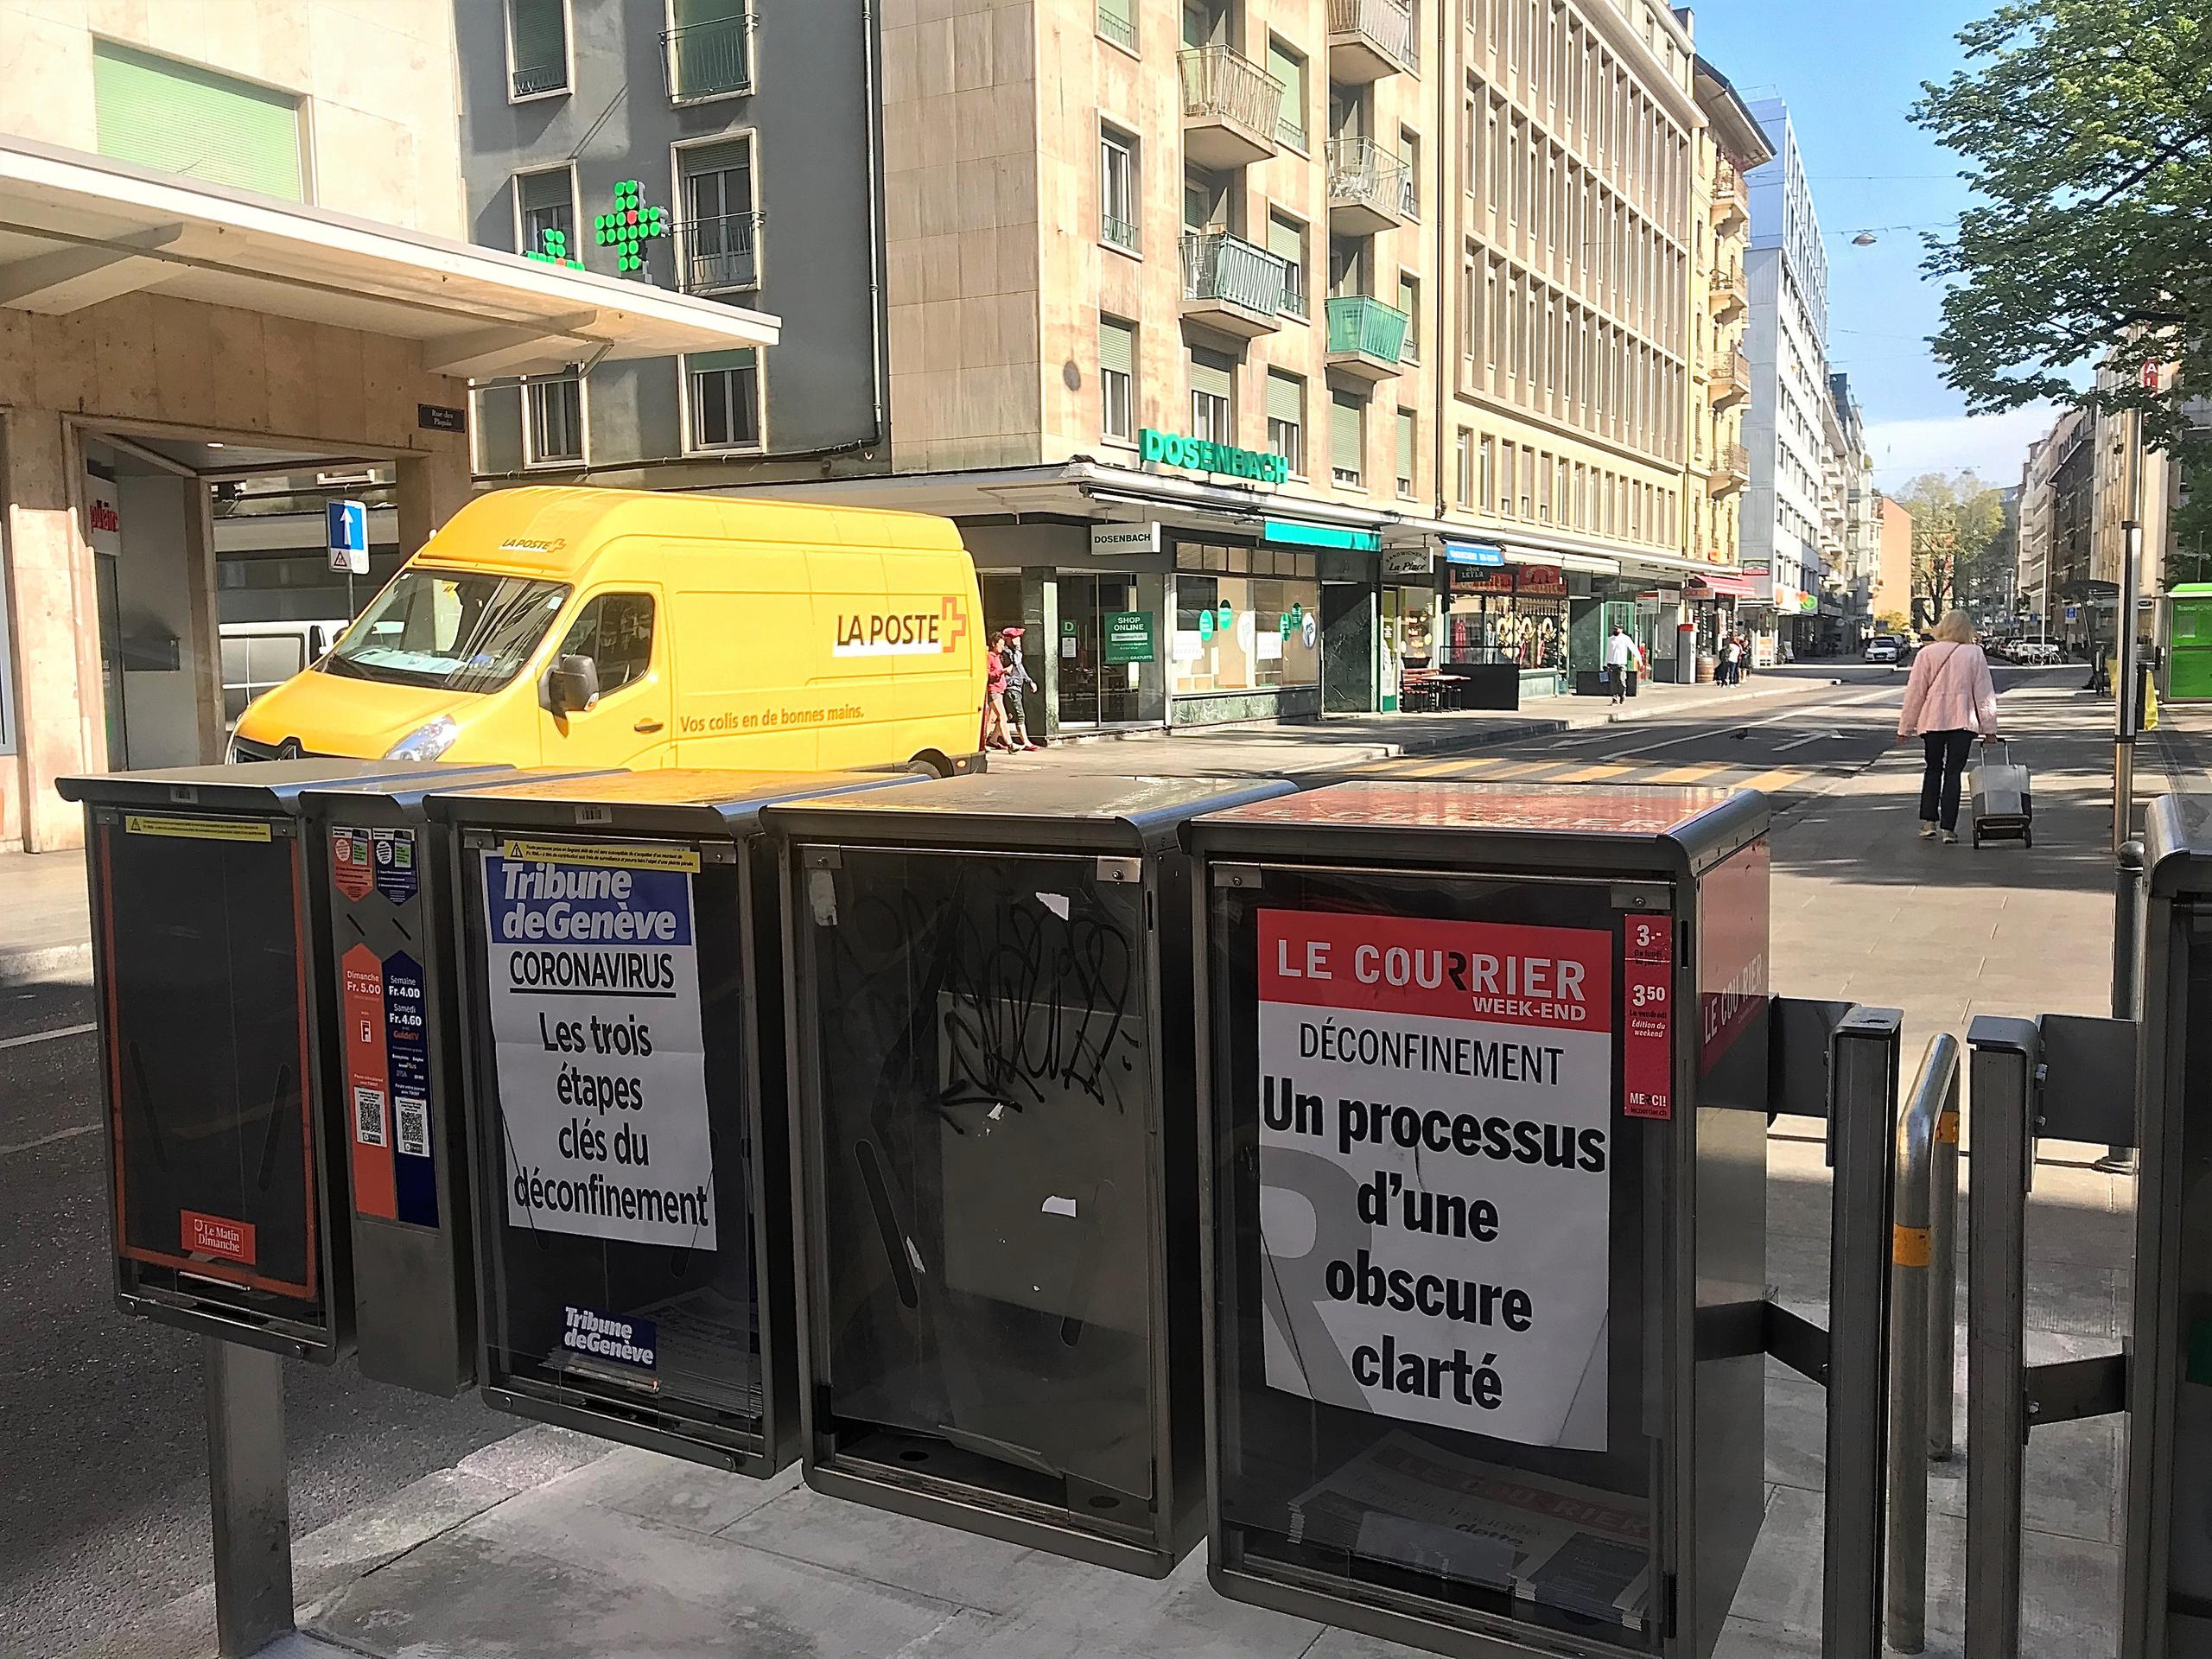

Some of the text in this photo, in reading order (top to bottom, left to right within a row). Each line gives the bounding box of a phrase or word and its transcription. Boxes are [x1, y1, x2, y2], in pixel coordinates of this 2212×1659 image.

[1139, 429, 1288, 484] DOSENBACH
[502, 538, 553, 550] LA POSTE
[1094, 534, 1151, 543] DOSENBACH
[1389, 562, 1426, 571] La Place
[836, 613, 940, 646] LA POSTE
[680, 703, 865, 734] Vos colis en de bonnes mains.
[502, 862, 632, 899] Tribune
[502, 902, 677, 940] deGenève
[347, 970, 378, 982] Dimanche
[391, 976, 416, 986] Semaine
[510, 950, 675, 989] CORONAVIRUS
[1278, 938, 1586, 1001] LE COURRIER
[394, 1003, 416, 1014] Samedi
[1472, 996, 1587, 1022] WEEK-END
[1632, 1019, 1656, 1028] Édition
[1705, 996, 1718, 1045] LE
[538, 1012, 653, 1057] Les trois
[1299, 1016, 1565, 1085] DÉCONFINEMENT
[1634, 1029, 1663, 1038] weekend
[557, 1061, 644, 1116] étapes
[559, 1117, 649, 1166] clés du
[1262, 1075, 1606, 1173] Un processus
[513, 1166, 709, 1227] déconfinement
[1356, 1169, 1499, 1243] d'une
[199, 1233, 240, 1252] Dimanche
[205, 1224, 239, 1242] Le Matin
[1325, 1249, 1533, 1333] obscure
[565, 1306, 632, 1339] Tribune
[563, 1328, 654, 1365] deGenève
[1351, 1334, 1503, 1410] clarté
